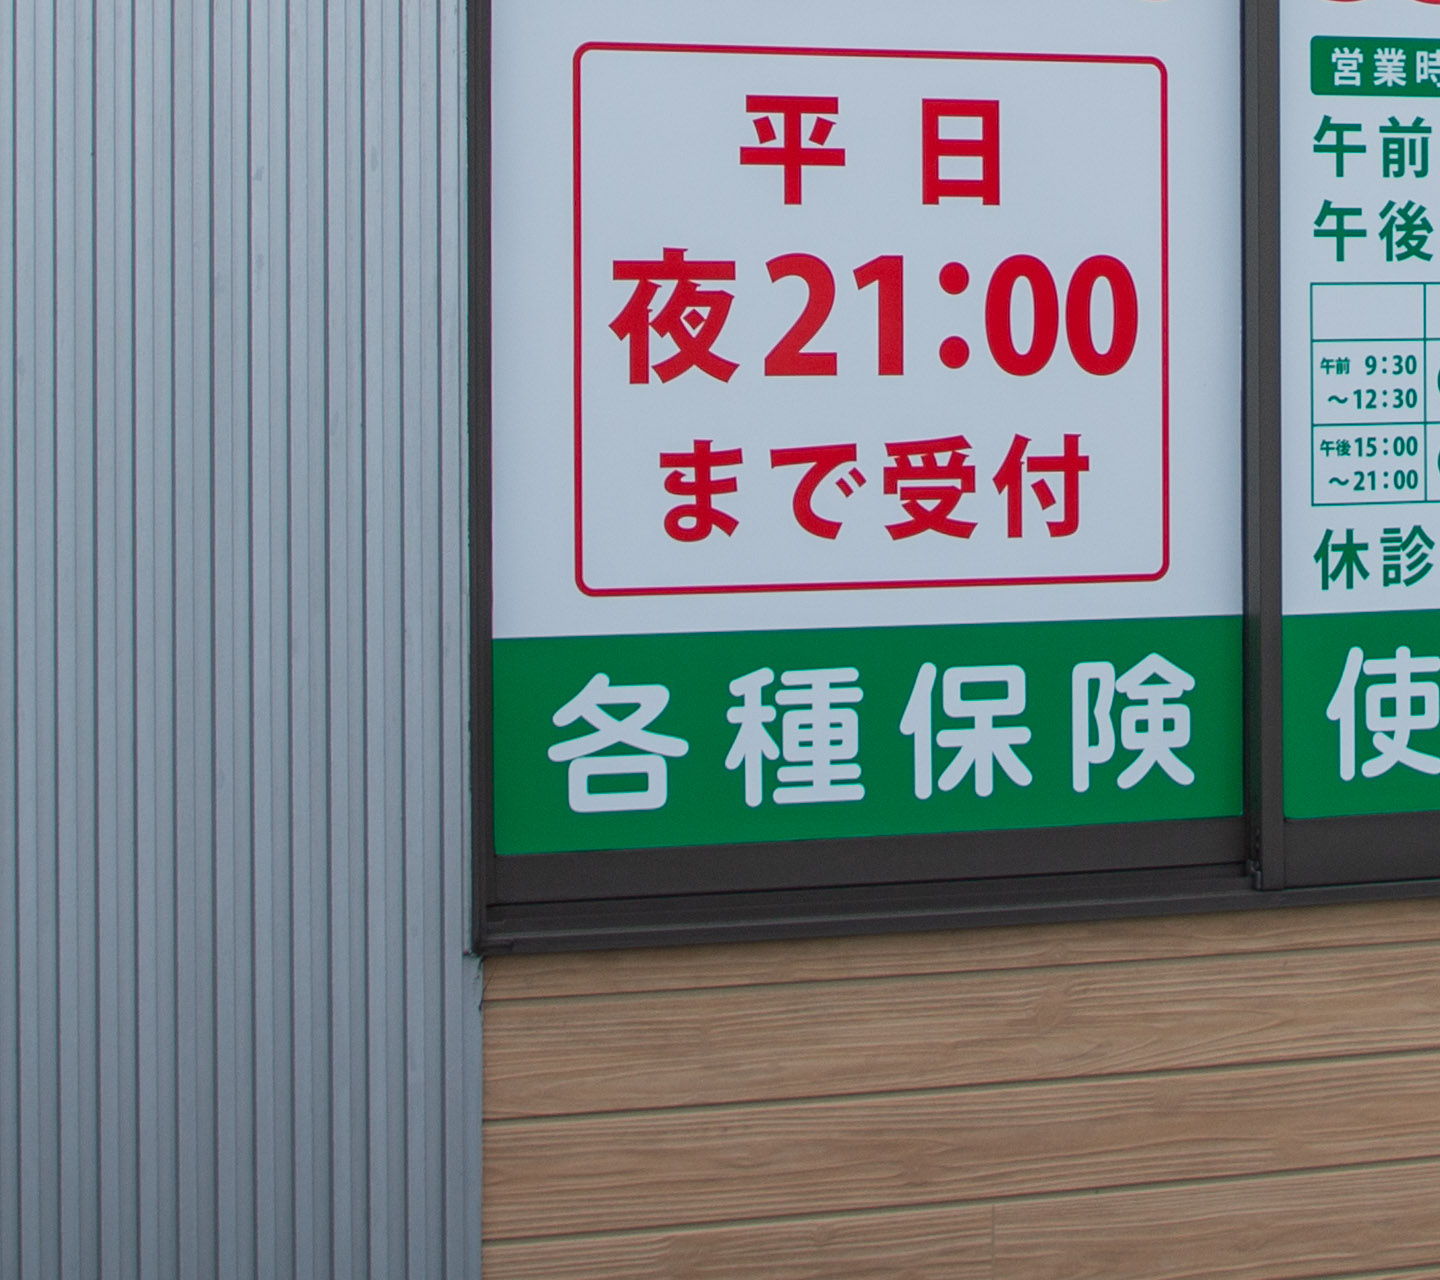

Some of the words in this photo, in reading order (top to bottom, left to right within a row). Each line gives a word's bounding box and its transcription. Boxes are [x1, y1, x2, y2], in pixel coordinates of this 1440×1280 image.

[740, 95, 1000, 205] 平日
[1313, 115, 1432, 178] 午前
[1314, 200, 1433, 262] 午後
[609, 248, 1138, 384] 夜21:00
[1320, 356, 1350, 375] 午前
[1365, 355, 1417, 375] 9:30
[660, 434, 1089, 542] まで受付
[548, 653, 1195, 812] 各種保険
